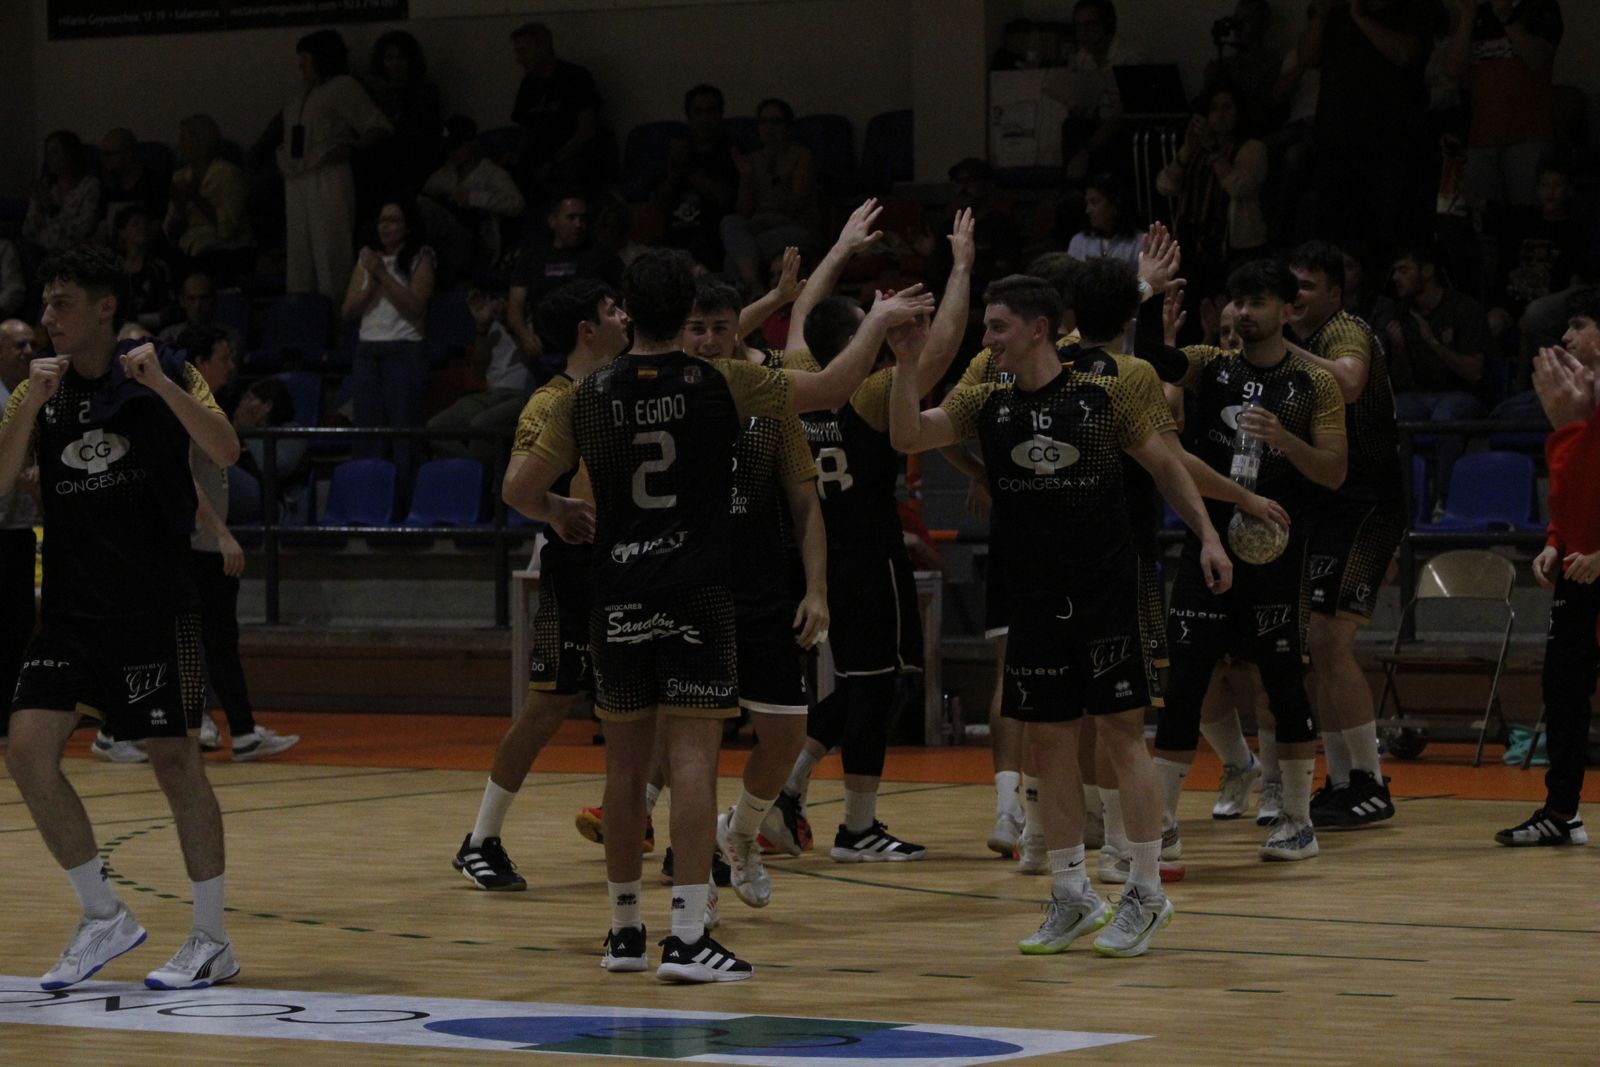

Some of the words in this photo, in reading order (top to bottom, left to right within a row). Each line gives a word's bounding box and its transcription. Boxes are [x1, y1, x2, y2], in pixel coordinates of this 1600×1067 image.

[611, 399, 629, 428] D.
[635, 393, 686, 425] EGIDO
[1030, 407, 1053, 432] 16
[79, 441, 112, 462] CG
[1028, 446, 1061, 463] CG
[632, 430, 677, 509] 2
[56, 471, 128, 496] CONGESA
[125, 662, 167, 699] Gil
